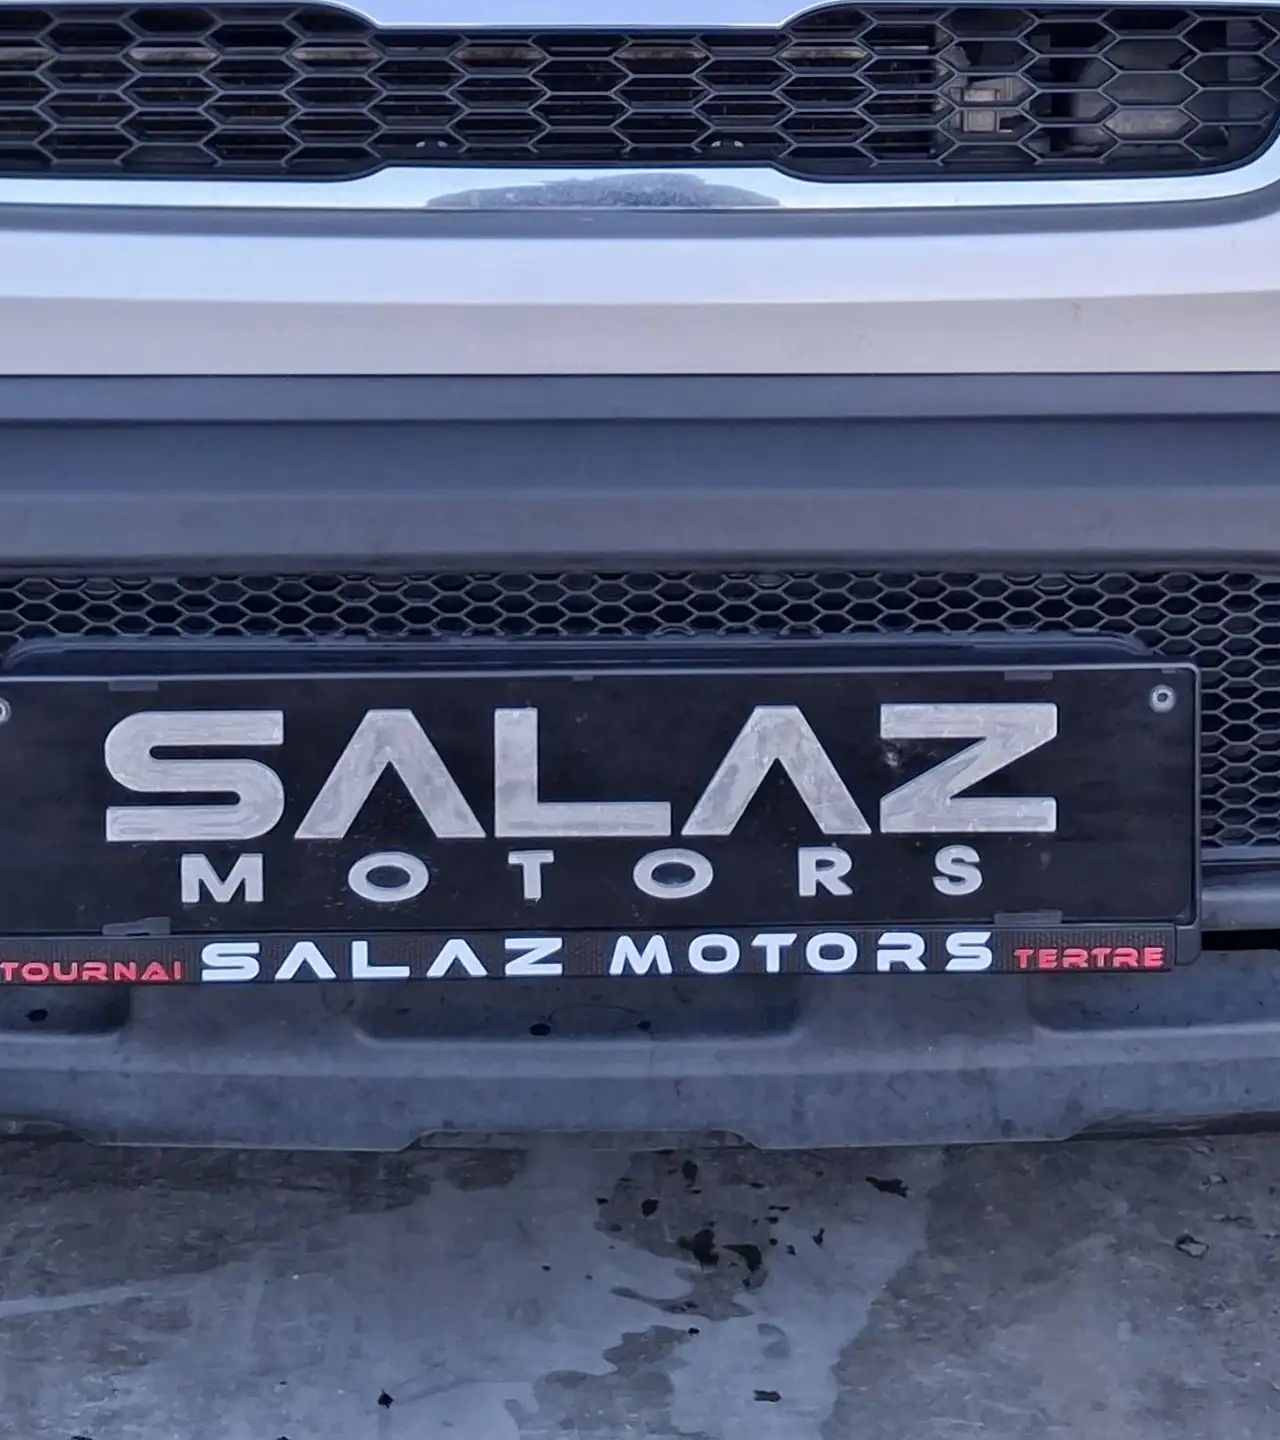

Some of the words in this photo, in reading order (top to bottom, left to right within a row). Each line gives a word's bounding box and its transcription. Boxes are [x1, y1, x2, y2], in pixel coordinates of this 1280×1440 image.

[104, 703, 1058, 842] SALAZ
[181, 844, 982, 903] MOTORS
[0, 961, 182, 981] TOURNAI
[201, 938, 563, 982] SALAZ
[609, 931, 993, 975] MOTORS
[1014, 947, 1164, 969] TERTRE
